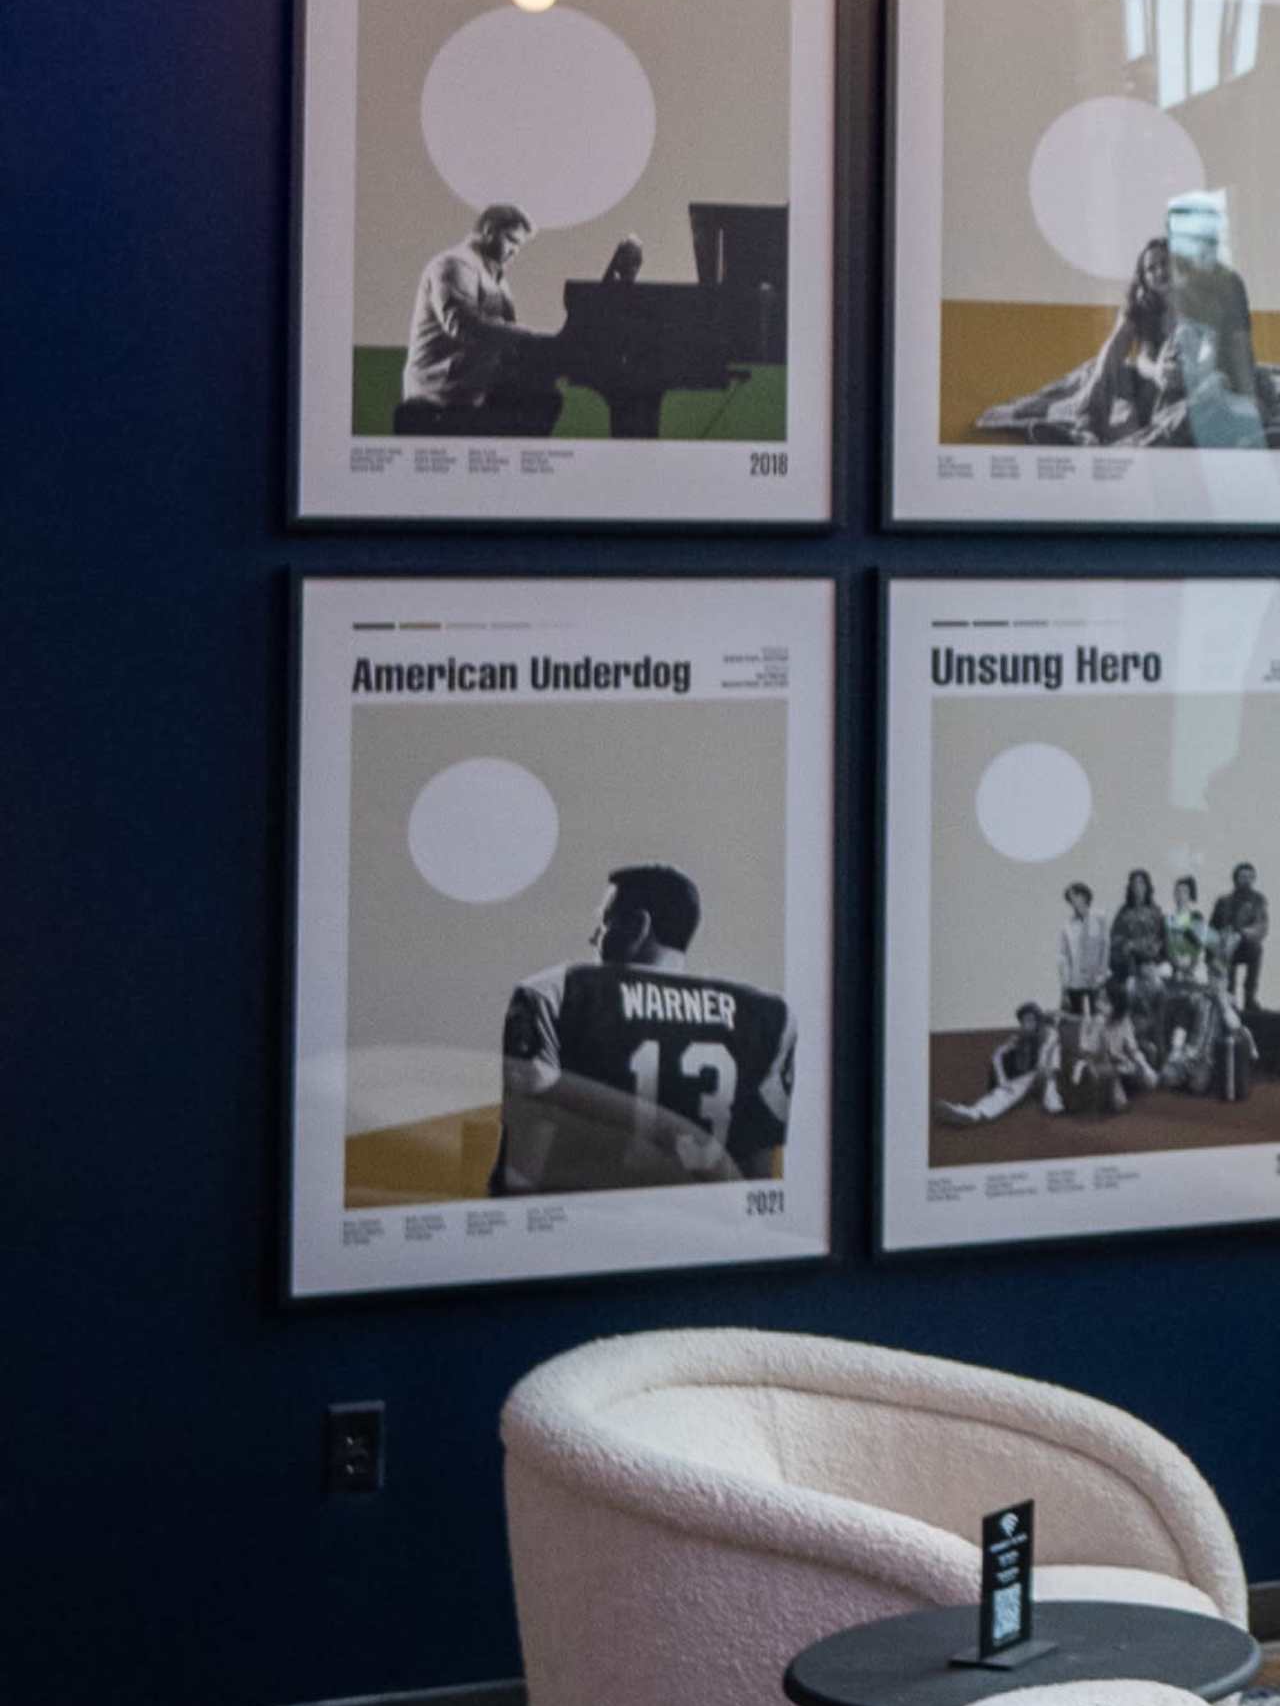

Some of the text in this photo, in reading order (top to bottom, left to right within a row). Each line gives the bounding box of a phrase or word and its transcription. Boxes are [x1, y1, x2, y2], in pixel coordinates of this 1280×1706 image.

[750, 452, 788, 477] 2018
[351, 656, 519, 693] American
[529, 655, 692, 693] Underdog
[931, 646, 1162, 691] Unsung Hero
[620, 981, 737, 1031] WARNER
[629, 1039, 738, 1169] 13
[746, 1189, 785, 1216] 2021
